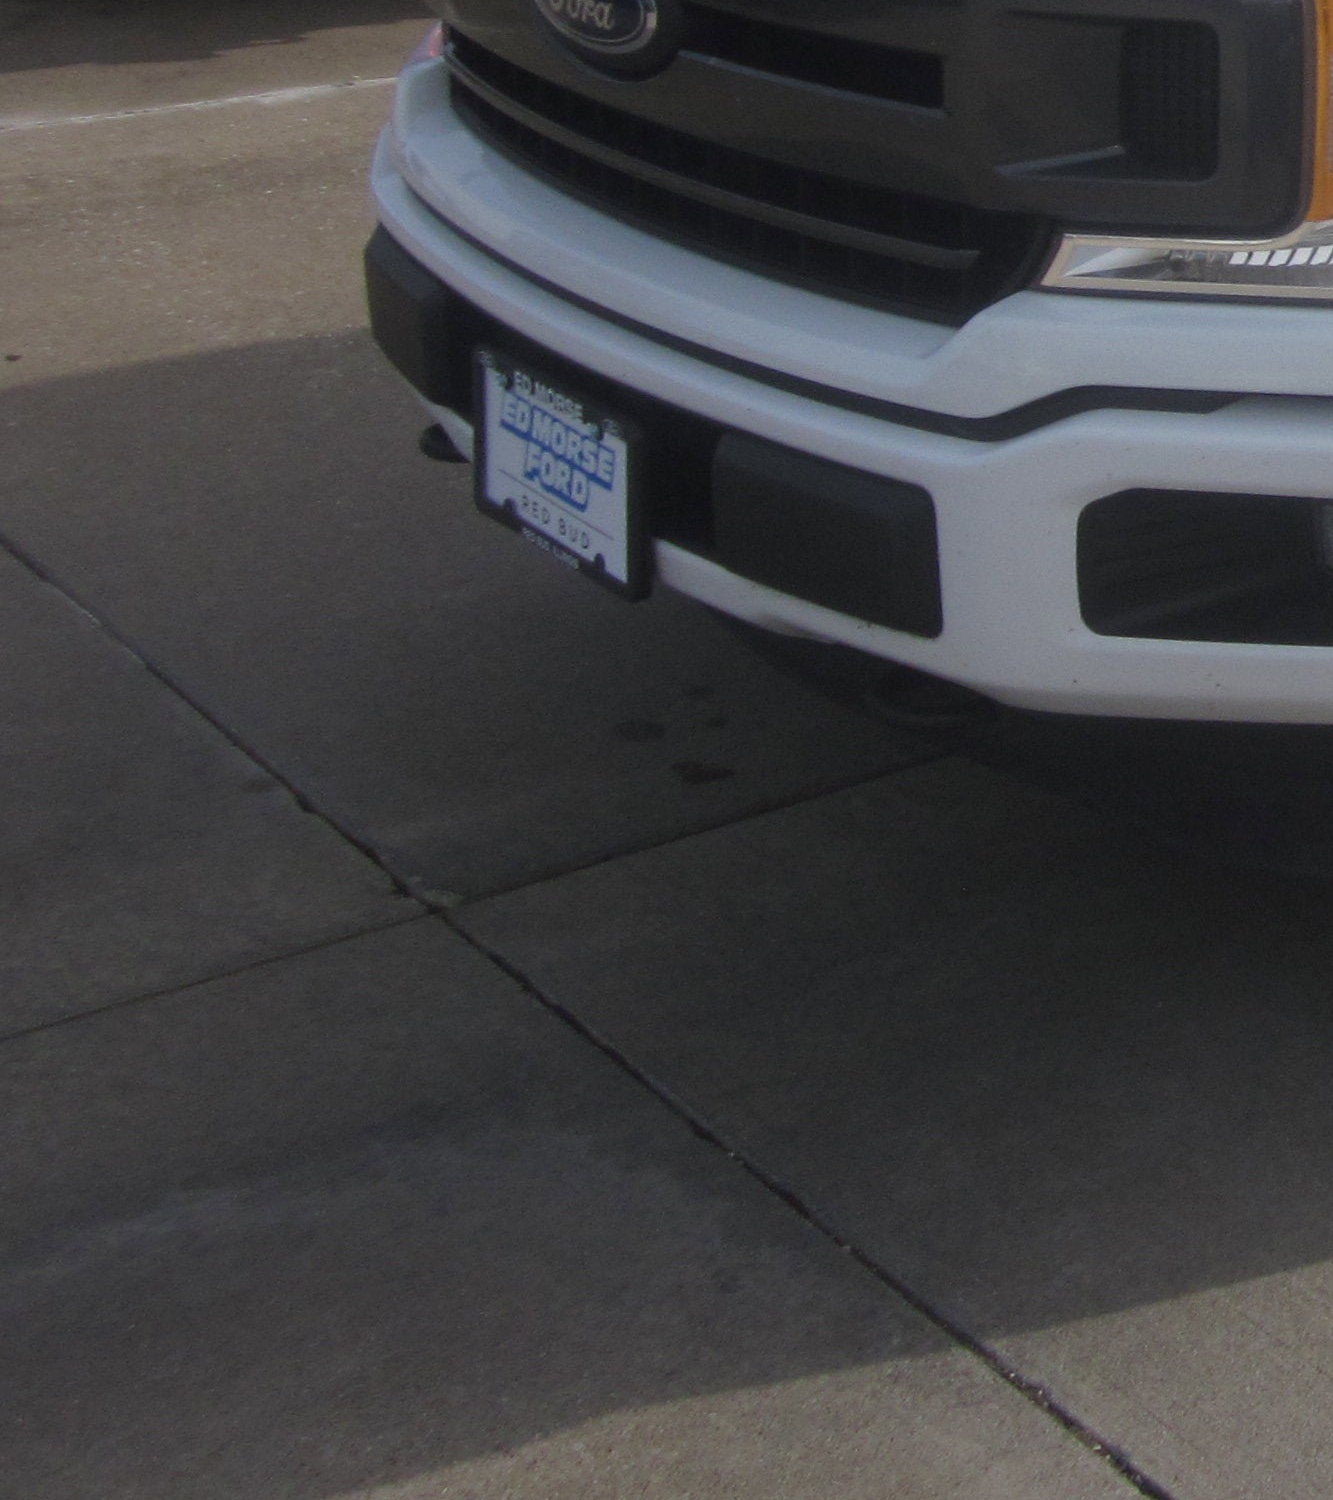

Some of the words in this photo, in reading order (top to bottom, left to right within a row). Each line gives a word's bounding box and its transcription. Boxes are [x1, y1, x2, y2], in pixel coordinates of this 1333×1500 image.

[500, 391, 531, 438] ED
[530, 403, 616, 491] MORSE
[524, 443, 590, 512] FORD
